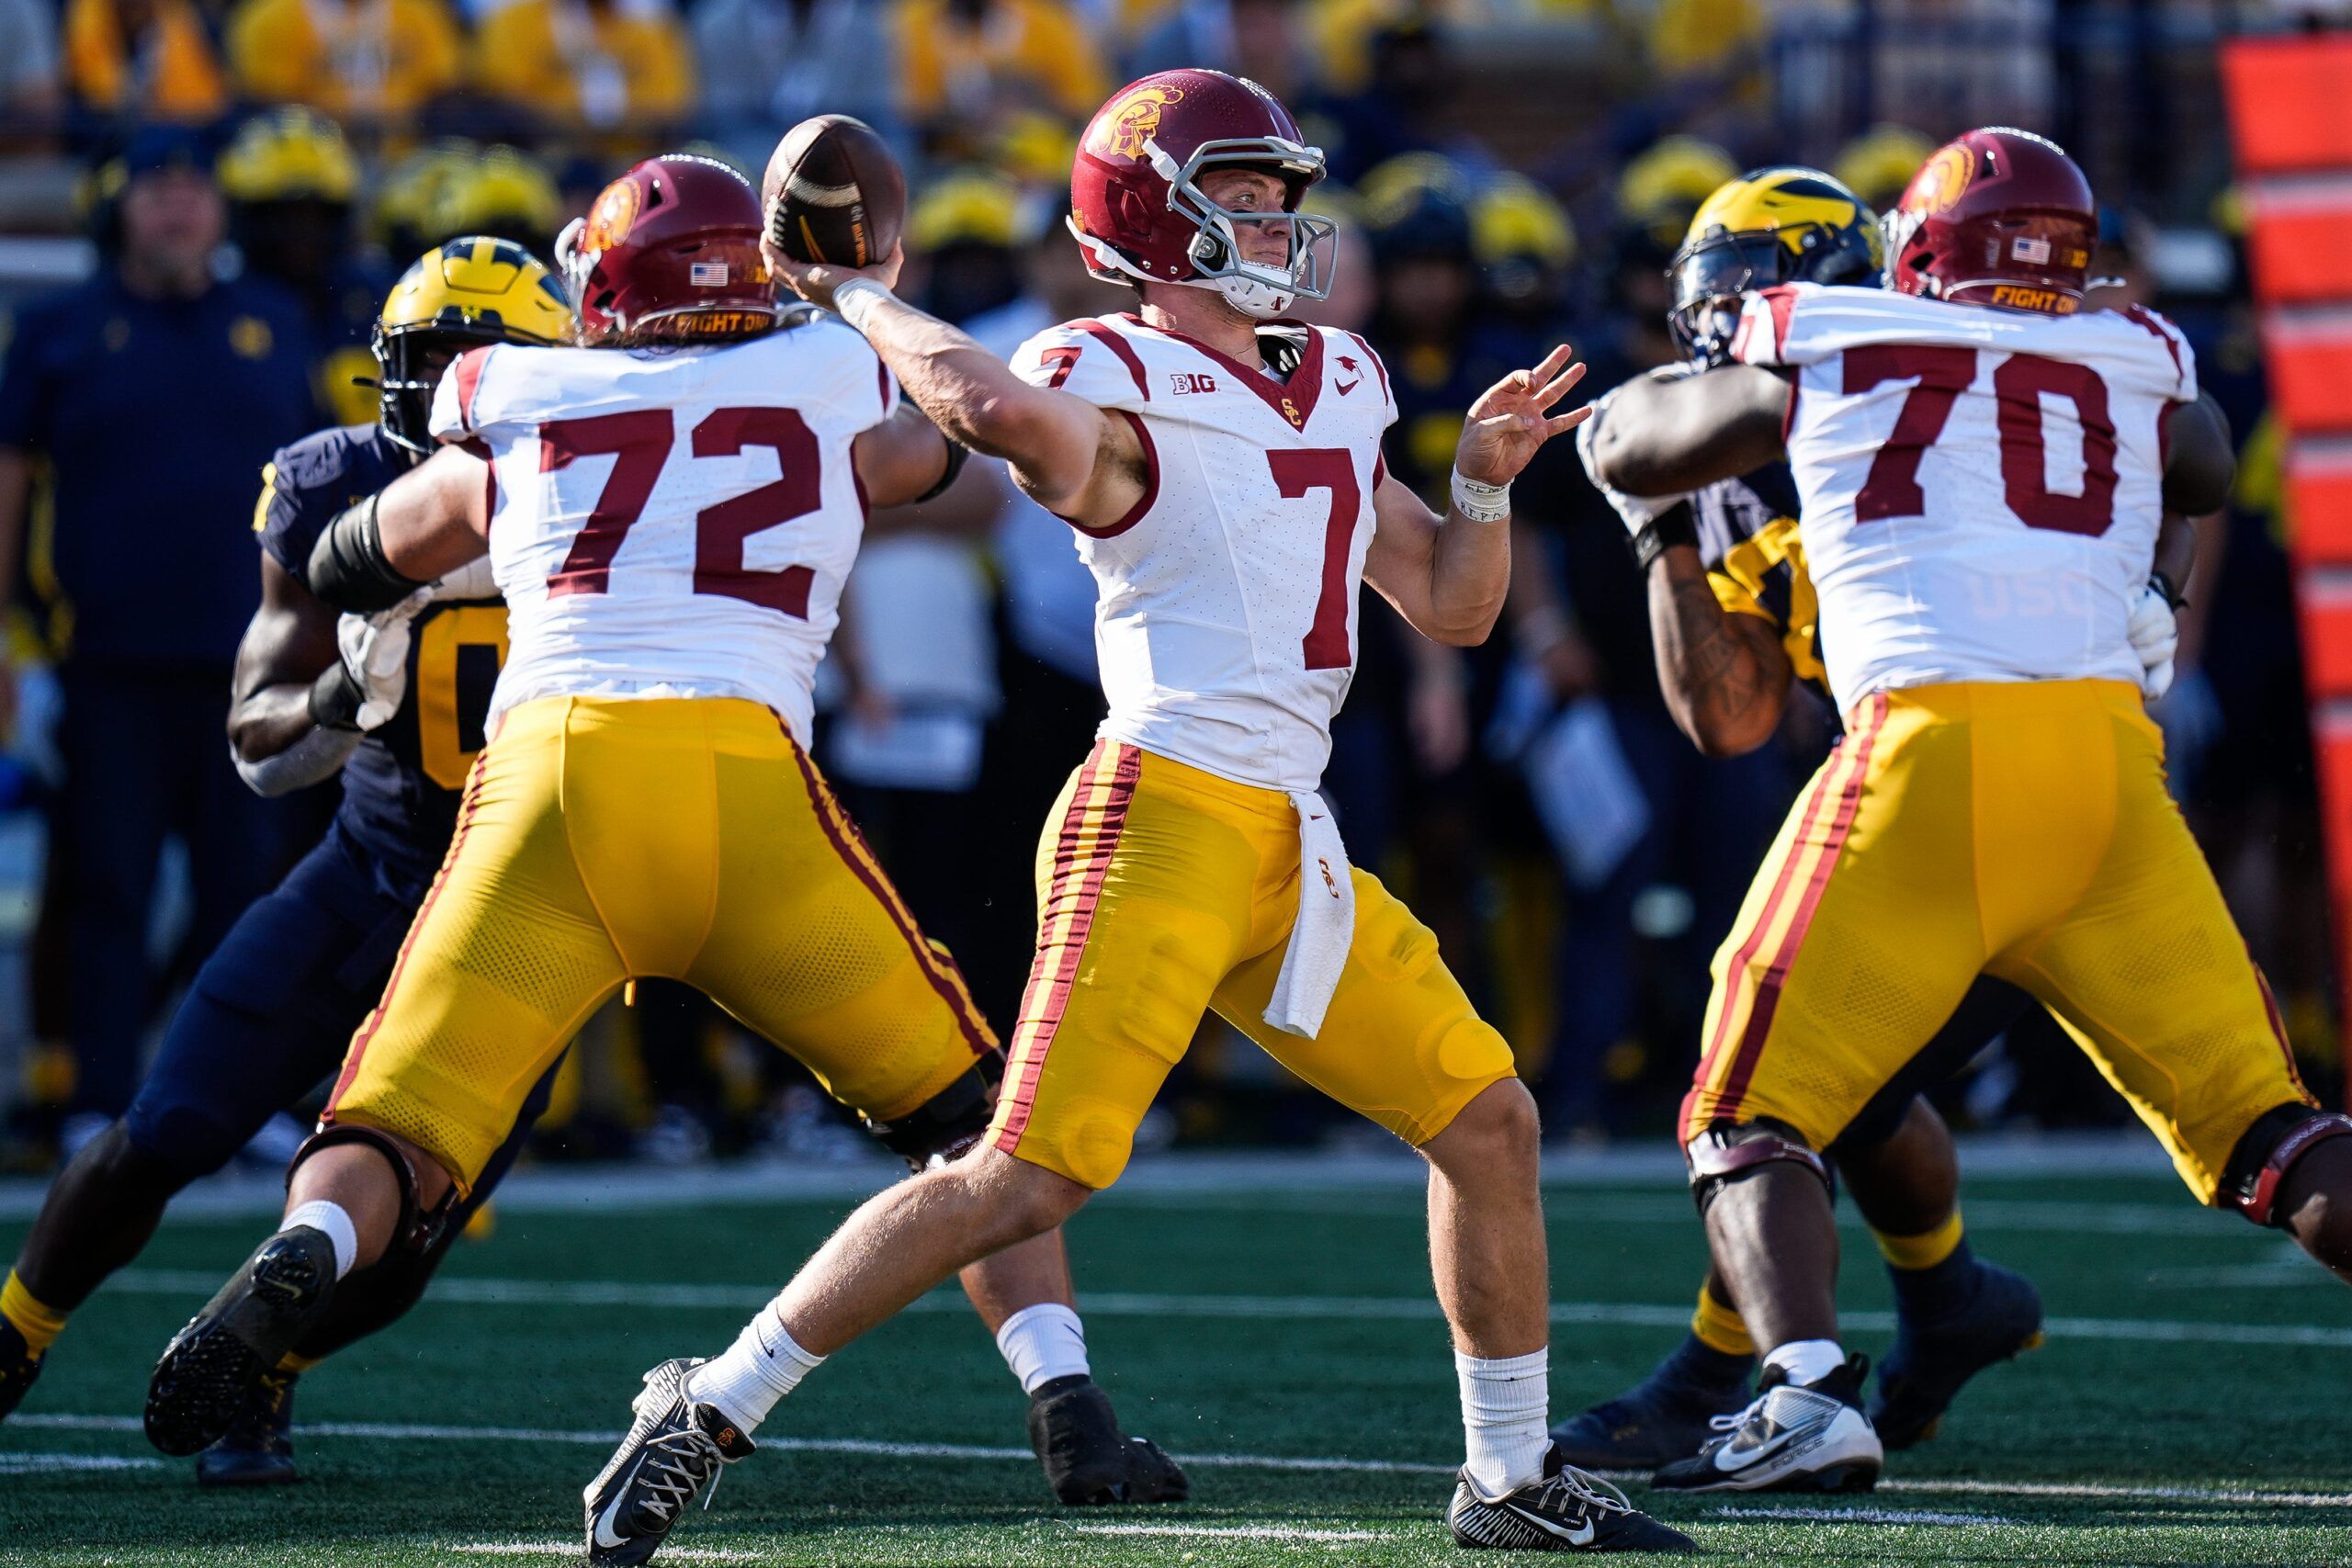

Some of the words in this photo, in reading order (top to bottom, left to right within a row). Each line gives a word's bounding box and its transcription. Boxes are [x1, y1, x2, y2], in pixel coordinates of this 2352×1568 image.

[1992, 286, 2057, 311] FIGHT
[676, 313, 742, 333] FIGHT
[1041, 346, 1083, 389] 7
[1281, 398, 1301, 425] SC
[1842, 344, 2120, 538] 70
[539, 406, 821, 623] 72
[1265, 447, 1361, 671] 7
[1770, 1436, 1826, 1469] FORCE
